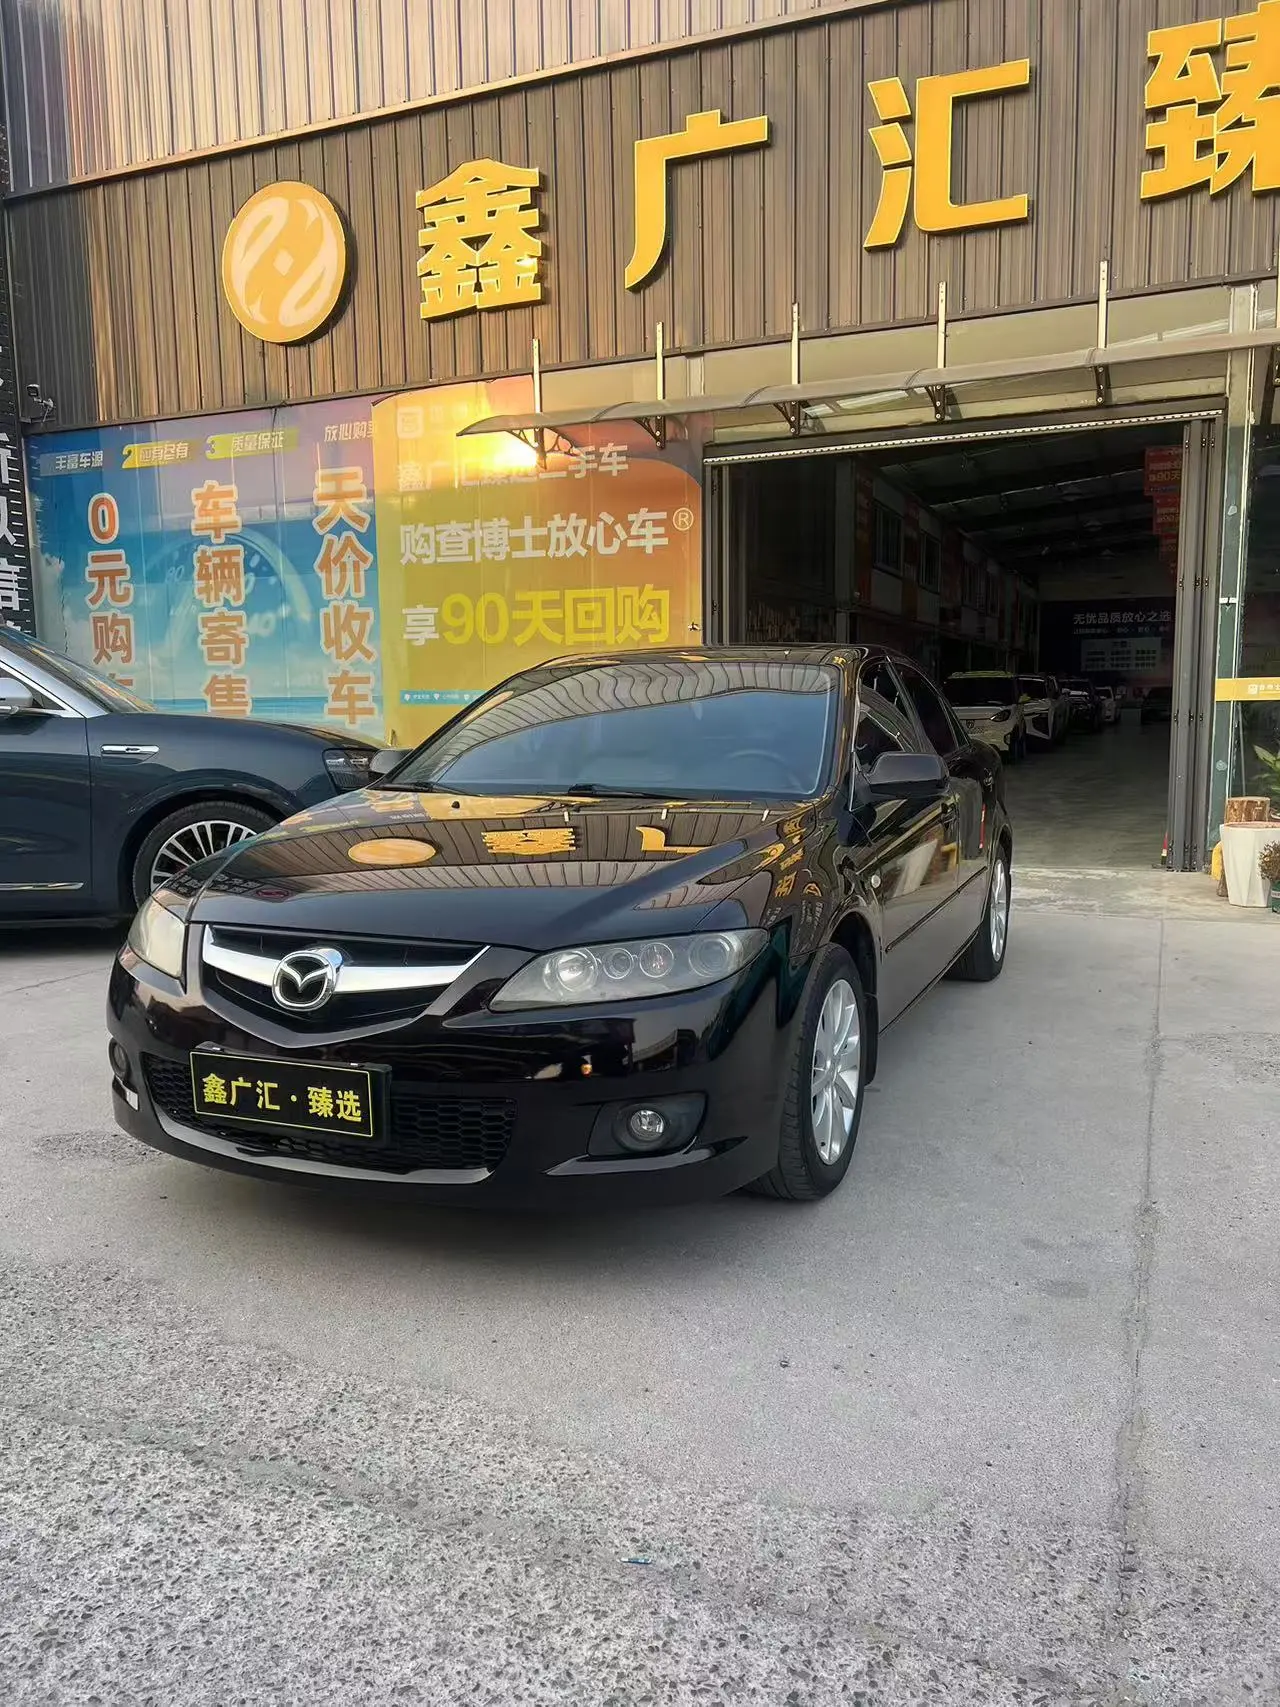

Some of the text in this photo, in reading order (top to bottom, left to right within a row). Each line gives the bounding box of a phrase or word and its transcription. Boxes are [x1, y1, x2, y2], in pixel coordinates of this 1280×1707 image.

[232, 431, 285, 452] 质量保证
[86, 494, 134, 687] 0元购
[313, 467, 377, 727] 天价收车
[402, 584, 670, 647] 享90天回购
[1073, 611, 1171, 625] 无忧品质放心之选
